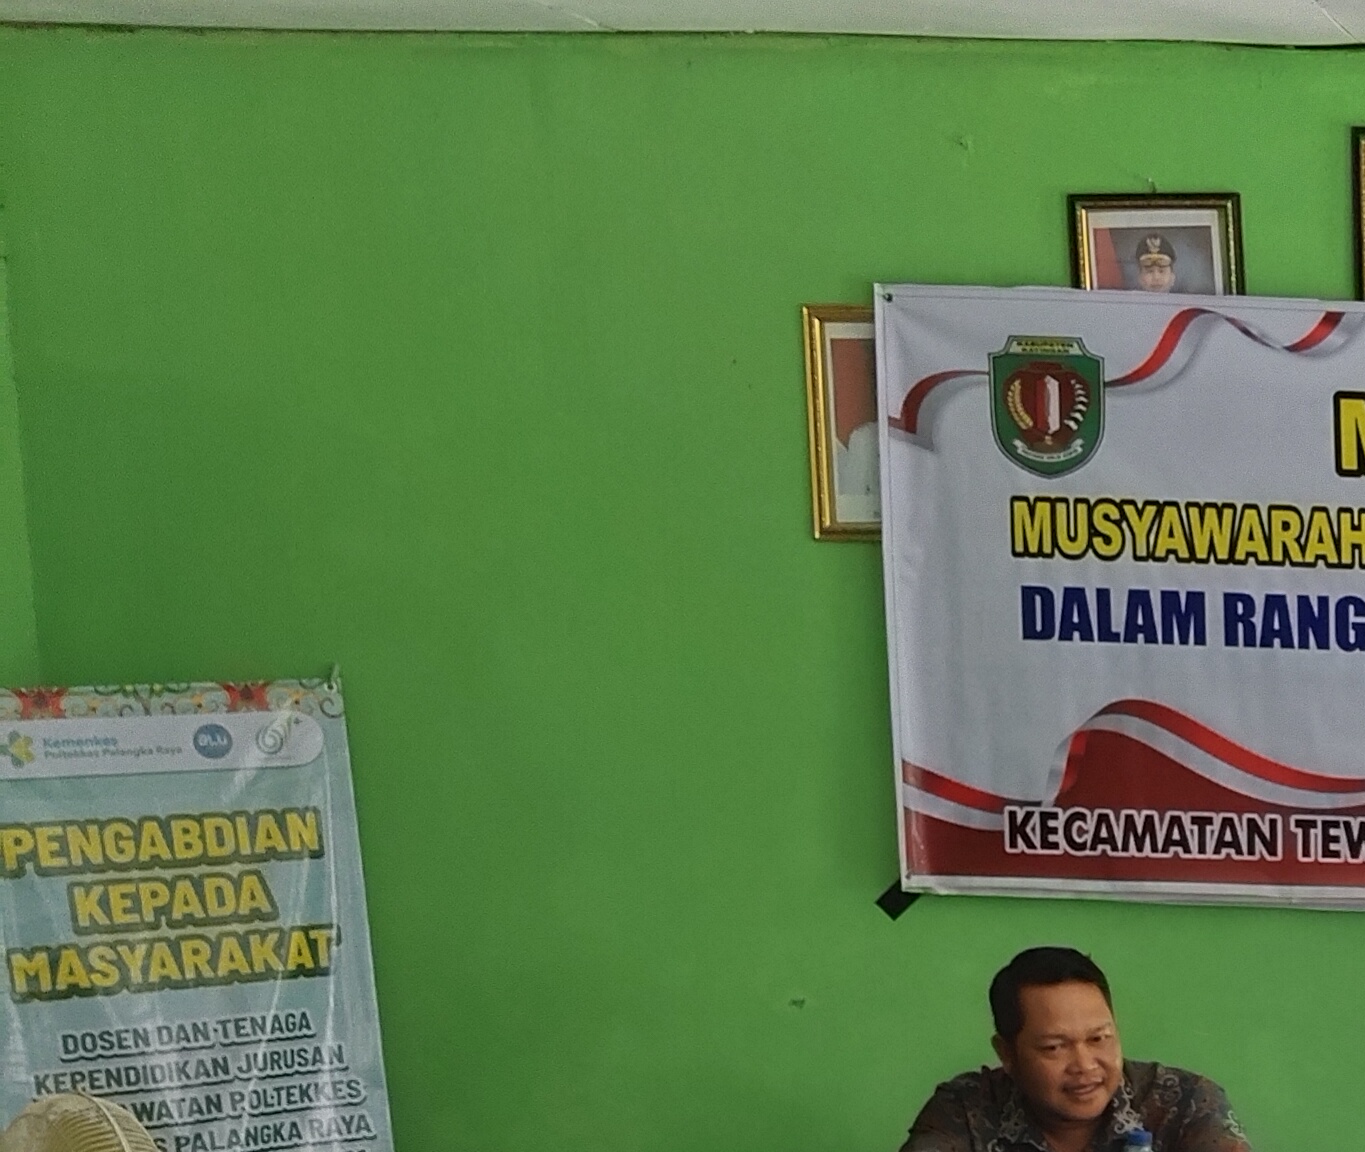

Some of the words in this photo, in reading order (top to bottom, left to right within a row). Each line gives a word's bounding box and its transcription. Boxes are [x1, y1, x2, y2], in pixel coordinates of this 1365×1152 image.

[1021, 585, 1206, 647] DALAM
[1, 810, 322, 873] PENGABDIAN
[1006, 810, 1282, 859] KECAMATAN
[73, 872, 274, 928] KEPADA
[10, 929, 332, 994] MASYARAKAT
[61, 1027, 151, 1056] DOSEN
[156, 1021, 211, 1049] DAN
[216, 1011, 312, 1041] TENAGA
[34, 1056, 230, 1097] KEPENDIDIKAN
[236, 1044, 346, 1076] JURUSAN
[229, 1079, 362, 1113] POLTEKKES
[308, 1113, 373, 1141] RAYA
